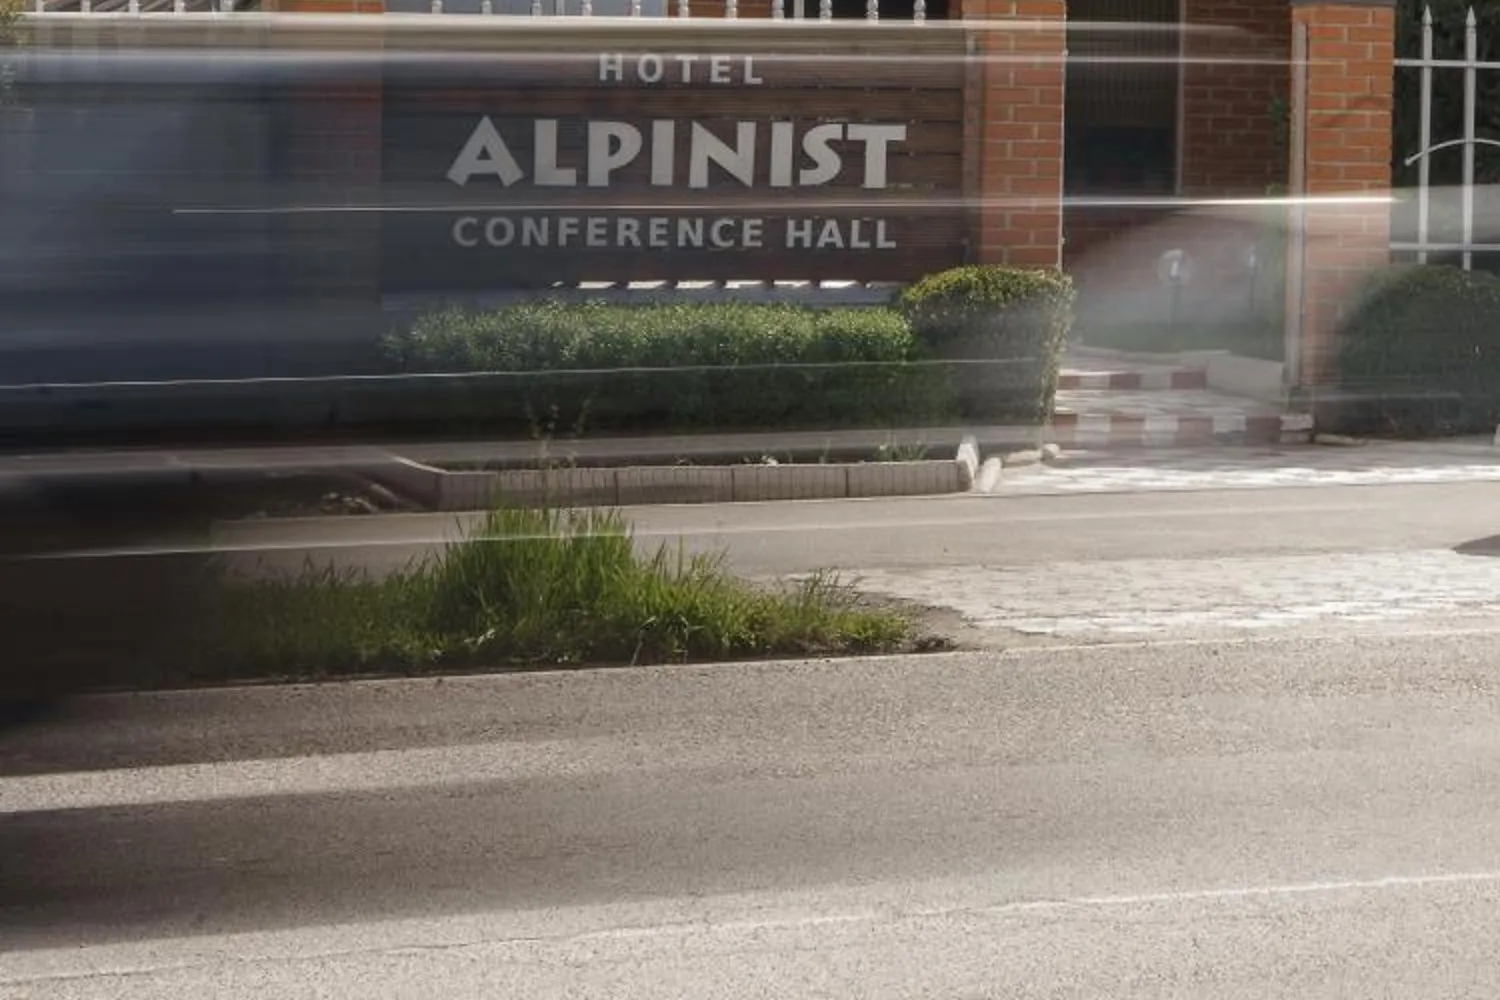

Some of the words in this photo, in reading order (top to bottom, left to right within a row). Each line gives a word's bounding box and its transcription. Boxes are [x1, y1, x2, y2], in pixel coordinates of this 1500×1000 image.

[599, 53, 764, 85] HOTEL
[446, 115, 908, 189] ALPINIST
[452, 217, 763, 248] CONFERENCE
[786, 218, 897, 249] HALL
